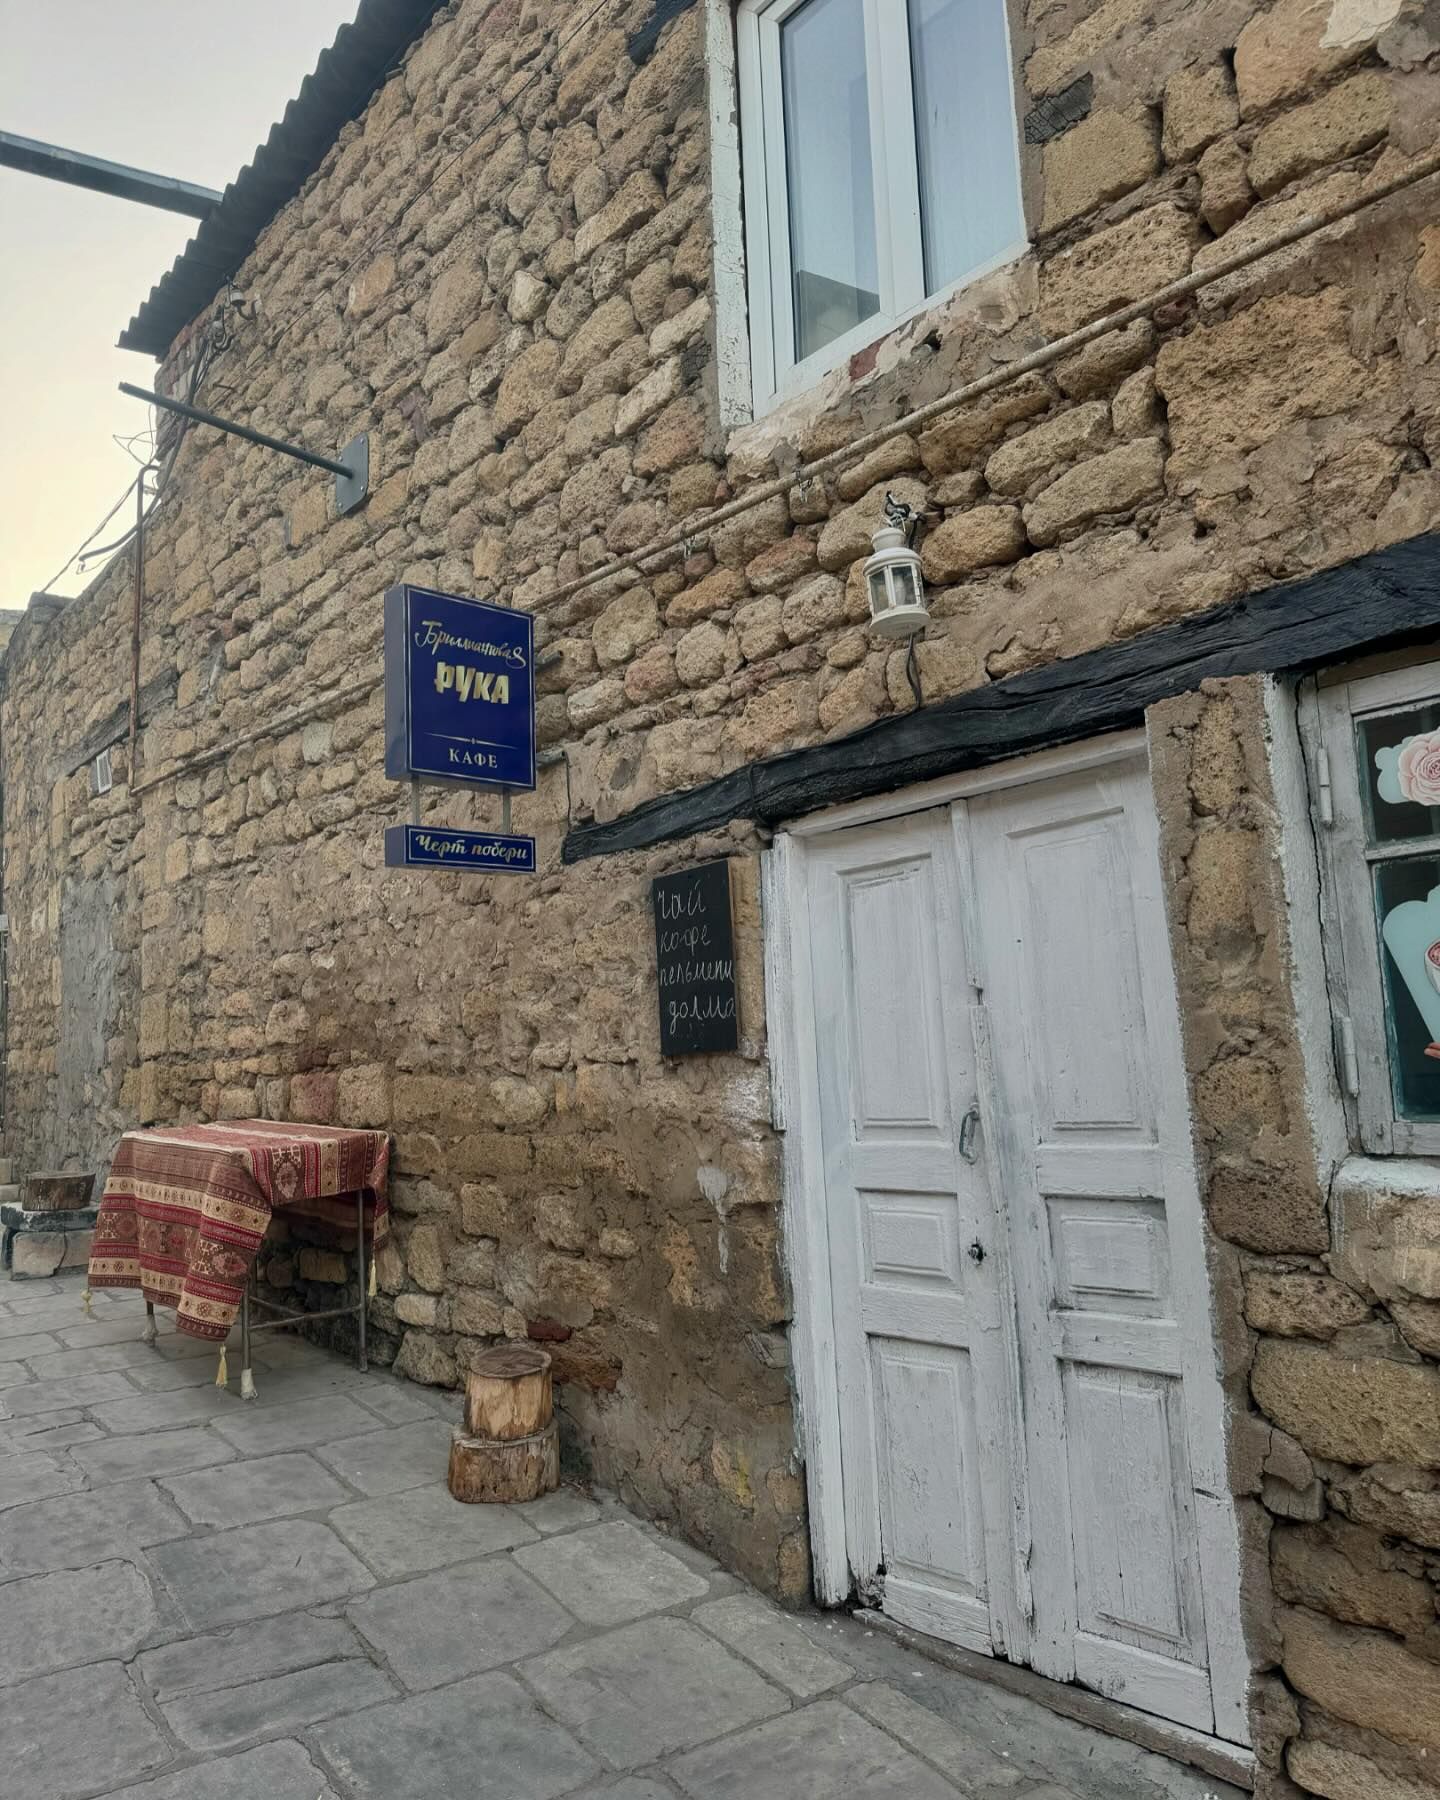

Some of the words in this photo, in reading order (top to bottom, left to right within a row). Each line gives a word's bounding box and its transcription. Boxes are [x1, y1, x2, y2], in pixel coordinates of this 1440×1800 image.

[449, 748, 498, 768] КАФЕ
[472, 843, 527, 861] побери
[669, 995, 736, 1034] долма
